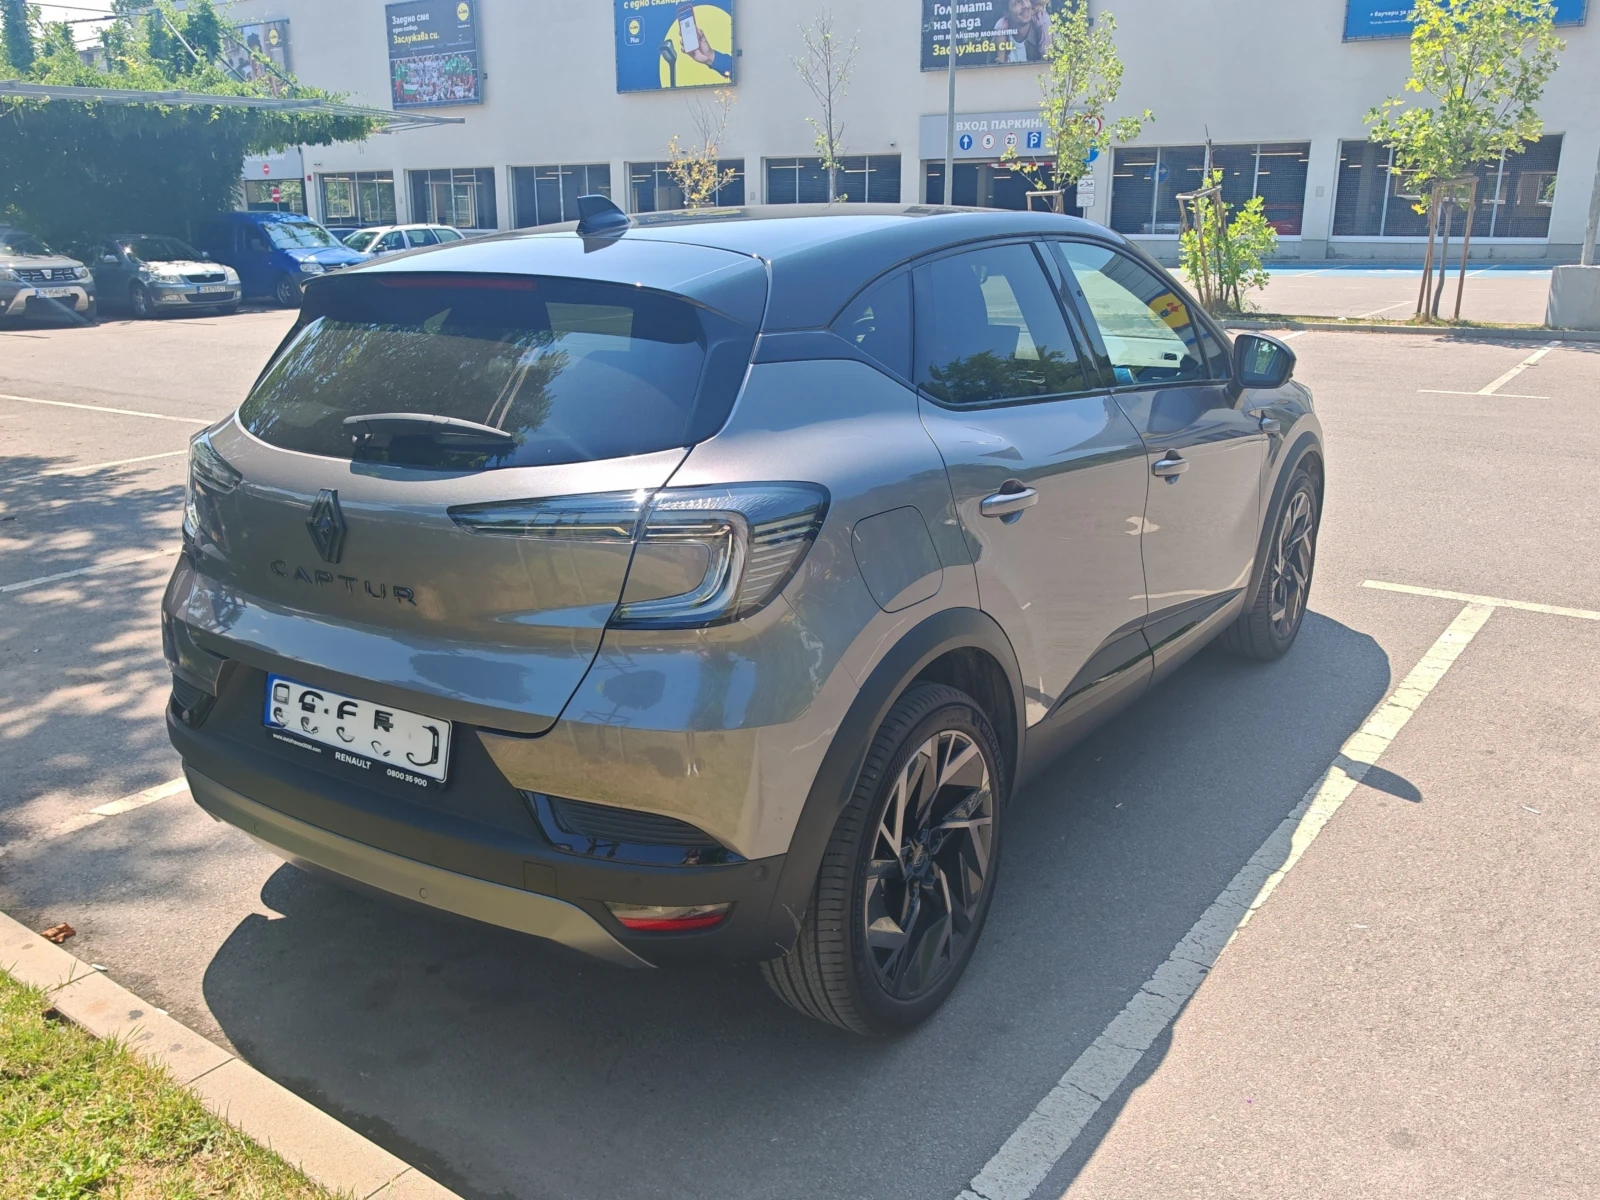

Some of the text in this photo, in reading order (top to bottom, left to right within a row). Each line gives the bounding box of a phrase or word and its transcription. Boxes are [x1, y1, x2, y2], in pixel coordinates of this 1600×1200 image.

[630, 0, 650, 10] едно
[392, 15, 415, 25] Заедно
[394, 32, 429, 44] Заслужава
[945, 31, 979, 40] млките
[981, 28, 1018, 37] моменти
[998, 41, 1017, 51] си.
[956, 121, 988, 132] ВХОД
[270, 559, 418, 607] CAPTUR
[335, 752, 371, 769] RENAULT
[386, 769, 428, 787] 0800 35 900
